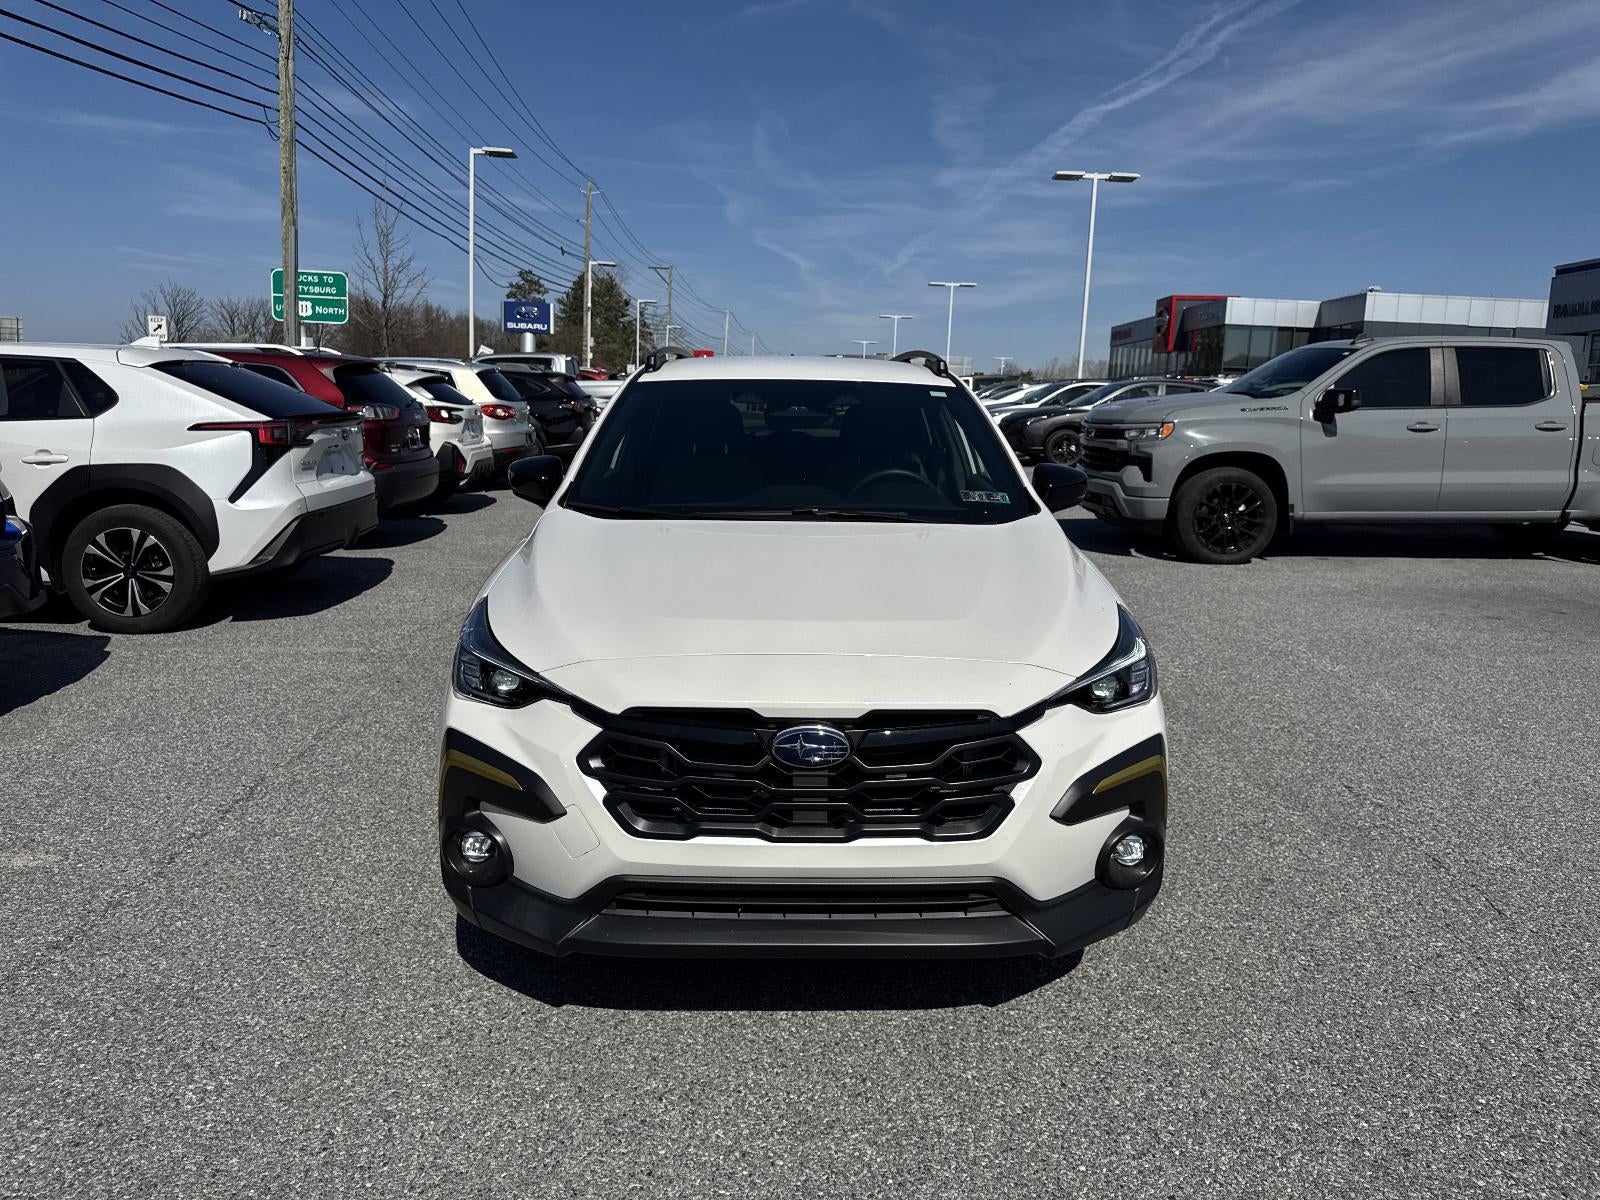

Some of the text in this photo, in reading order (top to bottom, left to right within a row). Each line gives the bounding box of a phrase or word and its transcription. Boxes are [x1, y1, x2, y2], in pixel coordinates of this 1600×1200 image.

[298, 275, 334, 284] UCKS TO
[298, 285, 337, 294] TYSBURG
[507, 322, 548, 331] SUBARU
